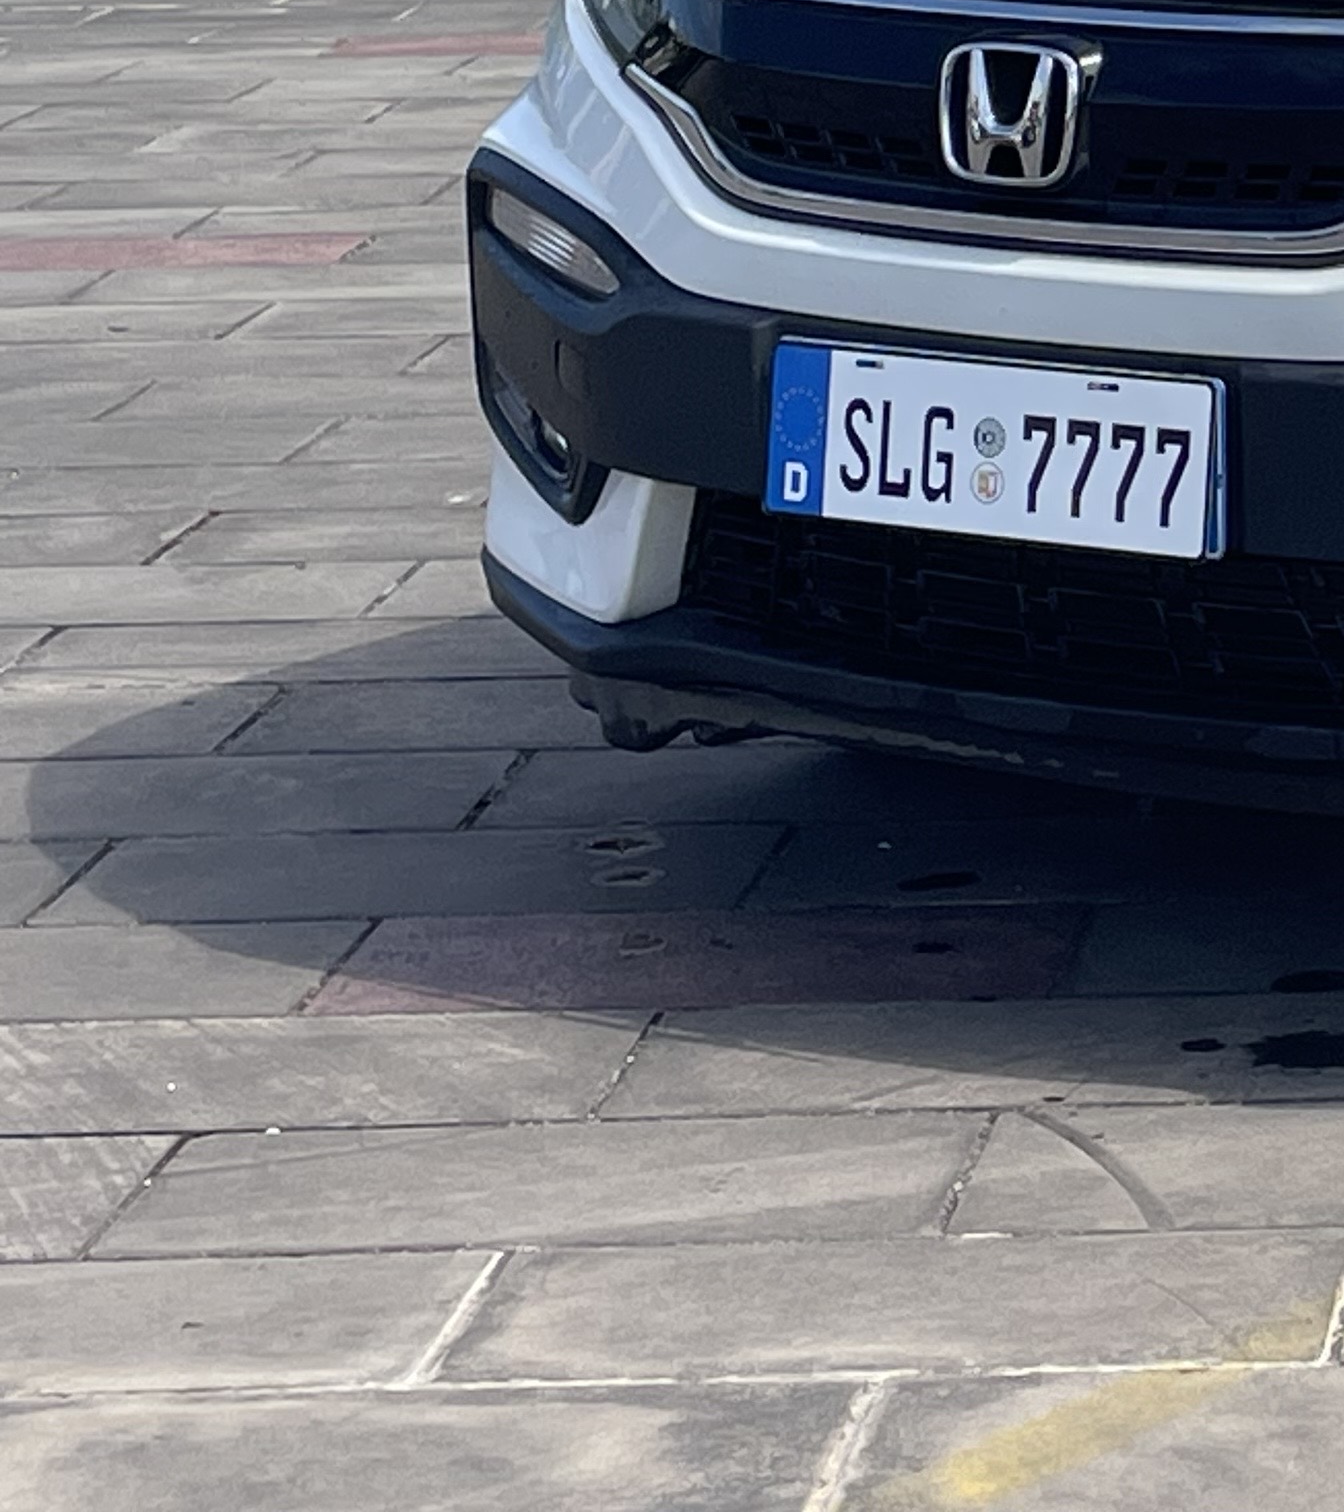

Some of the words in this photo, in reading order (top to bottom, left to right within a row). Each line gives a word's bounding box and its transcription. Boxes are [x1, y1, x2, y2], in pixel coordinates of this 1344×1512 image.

[783, 460, 808, 502] D
[839, 397, 955, 504] SLG
[1022, 413, 1192, 529] 7777
